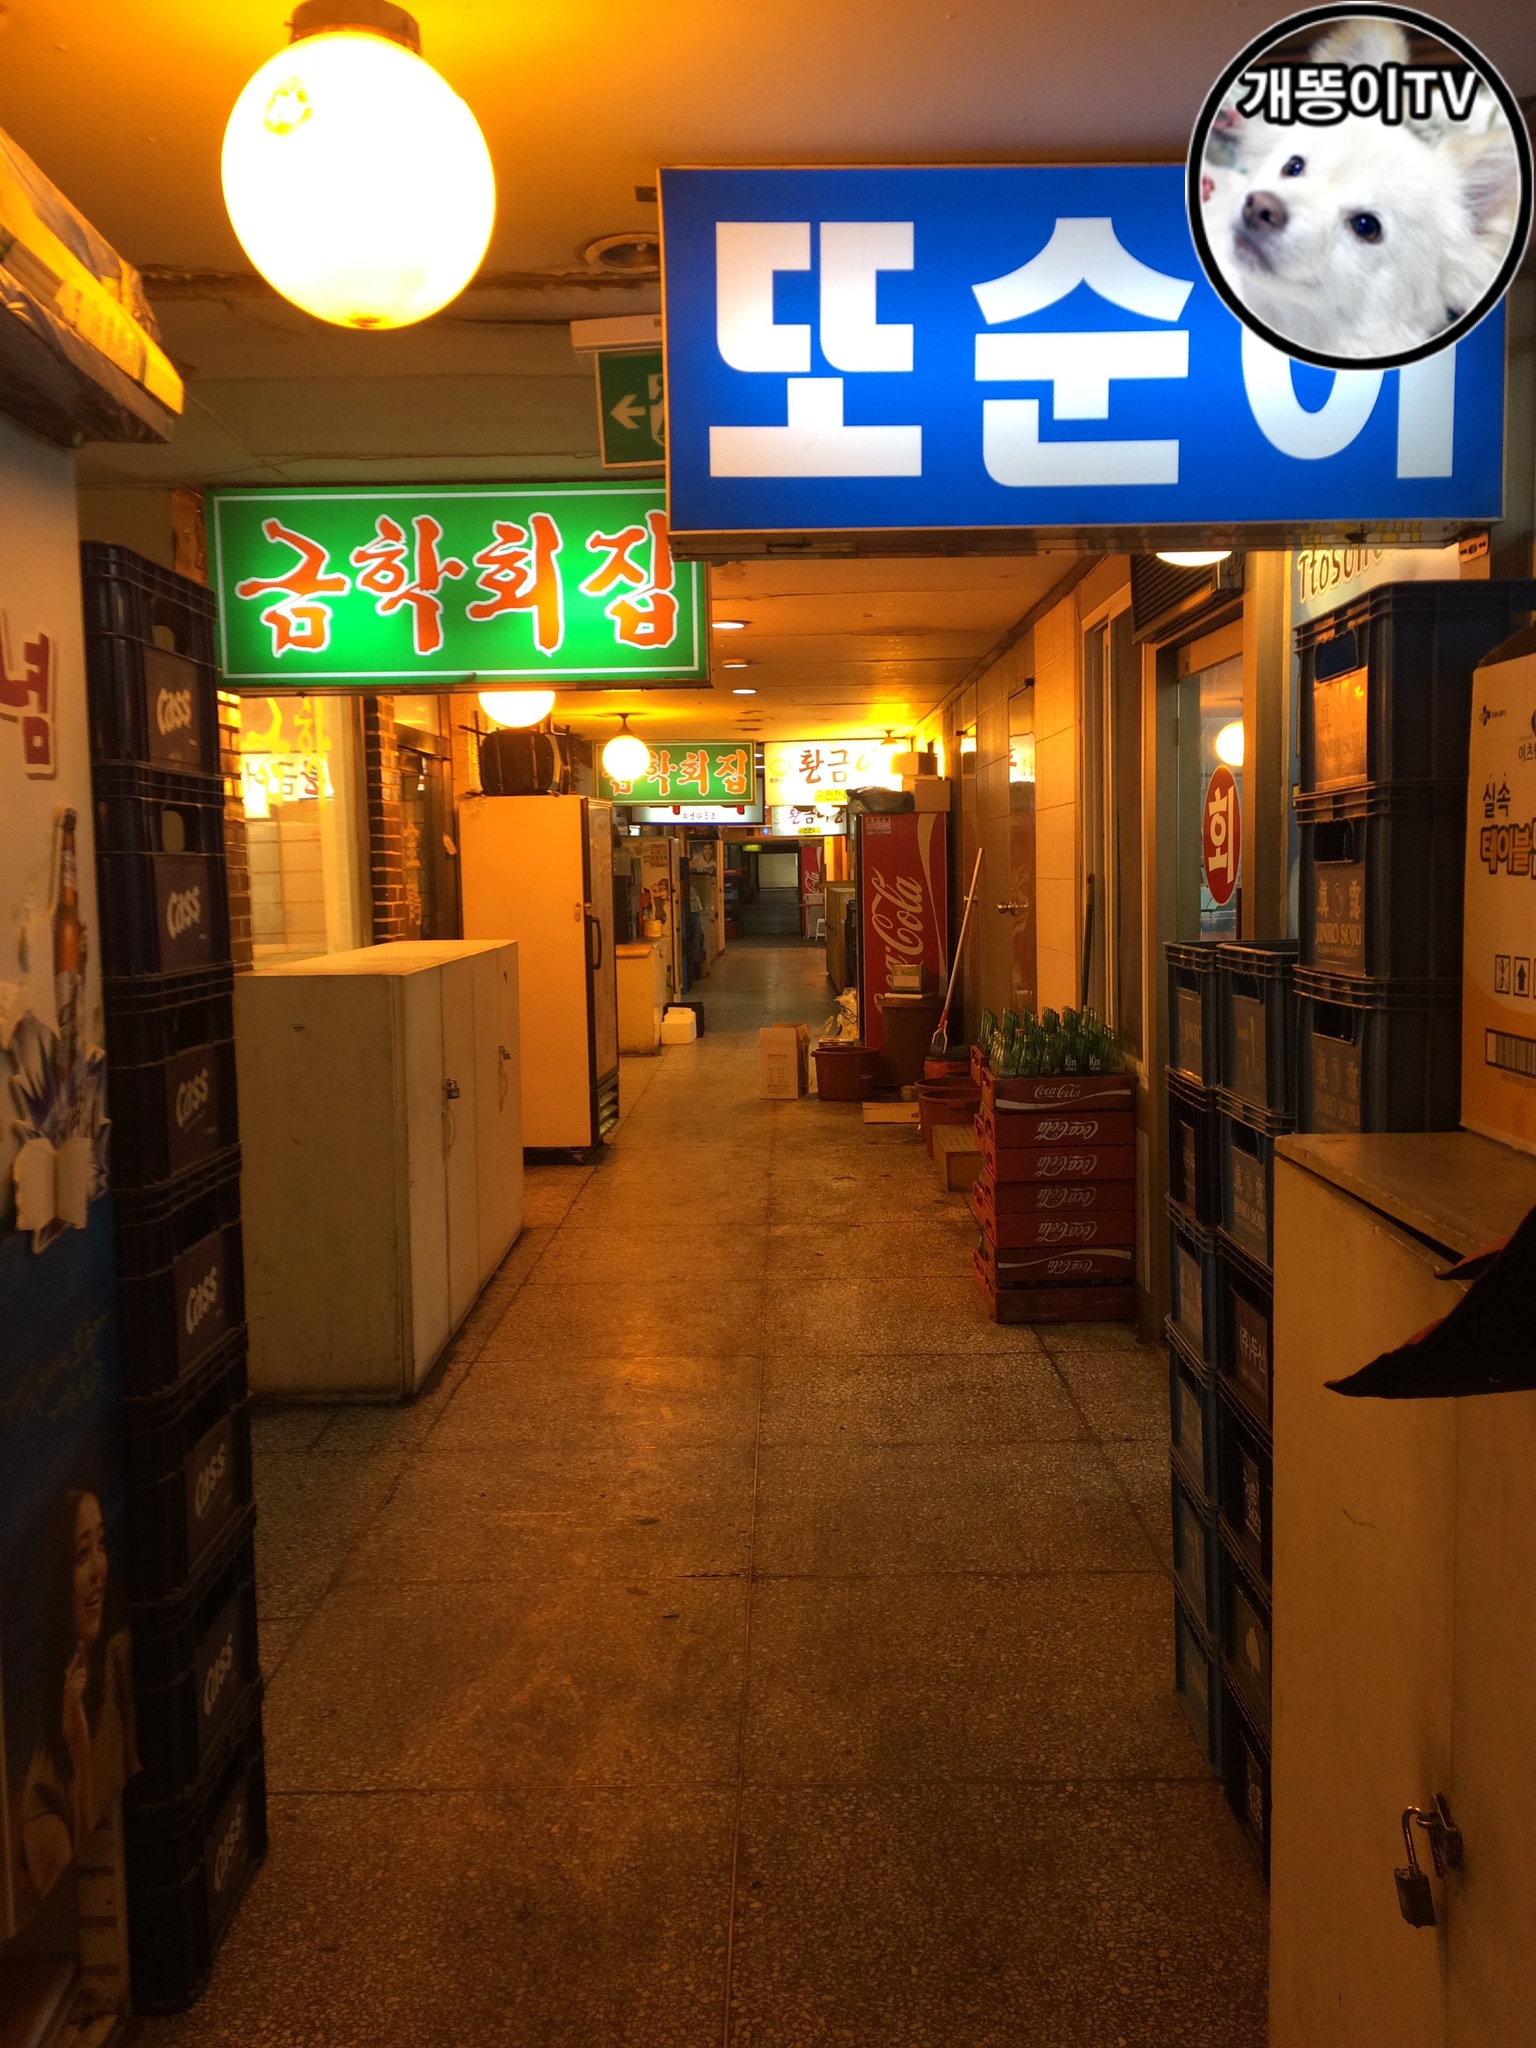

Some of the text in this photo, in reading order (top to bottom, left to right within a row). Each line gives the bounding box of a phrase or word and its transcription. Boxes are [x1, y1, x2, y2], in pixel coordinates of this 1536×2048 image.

[236, 510, 679, 657] 금학회집
[1518, 742, 1536, 763] 이츠
[1482, 779, 1511, 819] 실속
[1207, 785, 1235, 885] 회
[1480, 822, 1536, 879] 테이블
[1315, 922, 1362, 947] JINRO SOJU
